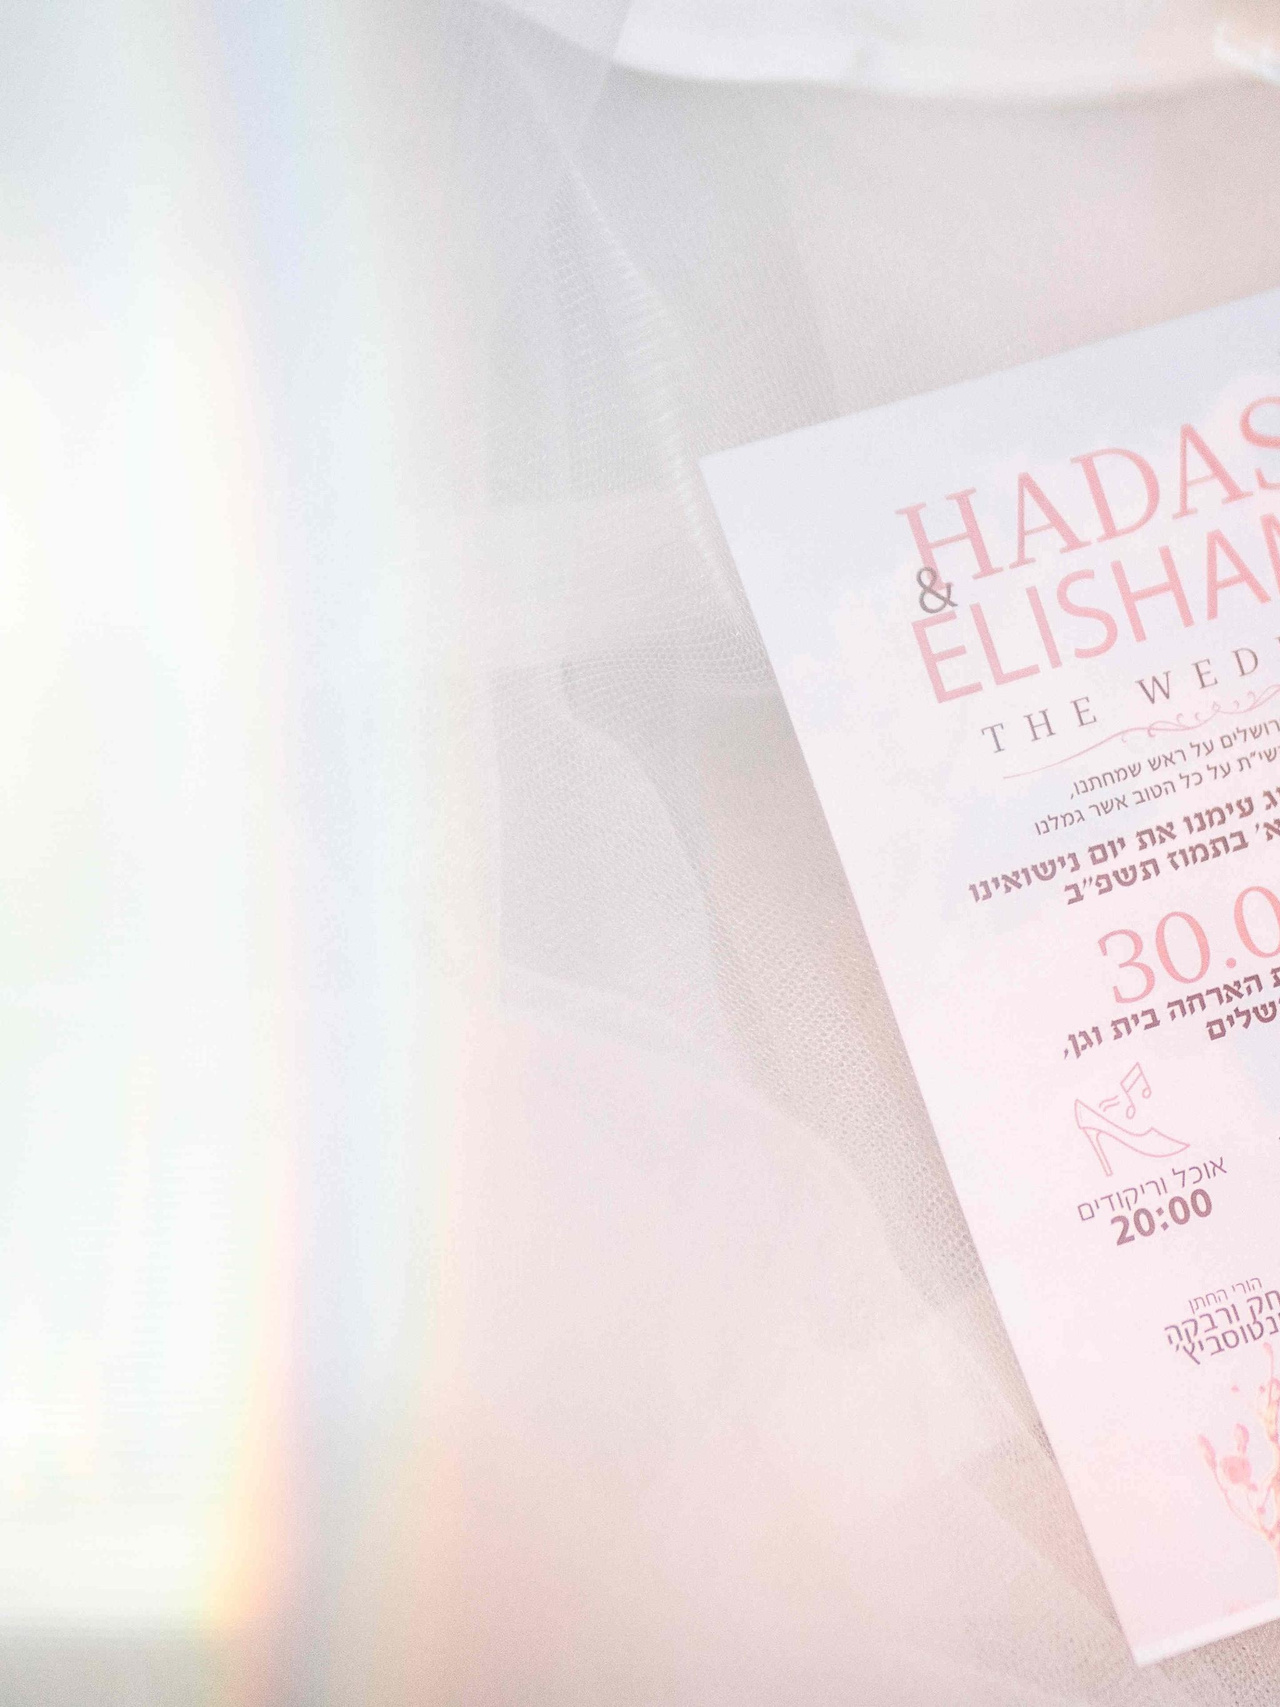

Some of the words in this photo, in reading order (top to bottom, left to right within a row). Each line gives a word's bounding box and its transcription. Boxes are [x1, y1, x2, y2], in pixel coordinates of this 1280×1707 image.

[916, 566, 958, 614] &
[980, 696, 1097, 753] THE
[1147, 748, 1186, 771] ראש
[1189, 739, 1214, 757] על
[1070, 761, 1141, 799] שמחתנו,
[1178, 771, 1203, 788] כל
[1205, 761, 1231, 779] על
[1088, 794, 1128, 816] אשר
[1131, 780, 1176, 804] הטוב
[1034, 809, 1085, 835] גמלנו
[1182, 796, 1254, 834] עימנו
[1087, 836, 1126, 865] יום
[1135, 821, 1176, 850] את
[1166, 830, 1248, 870] בתמוז
[968, 851, 1080, 902] נישואינו
[1166, 973, 1263, 1021] הארחה
[1110, 1007, 1160, 1040] בית
[1171, 1156, 1227, 1188] אוכל
[1076, 1176, 1168, 1221] וריקודים
[1110, 1188, 1212, 1246] 20:00
[1187, 1288, 1228, 1313] החתן
[1231, 1276, 1262, 1293] הורי
[1164, 1303, 1240, 1344] ורבקה
